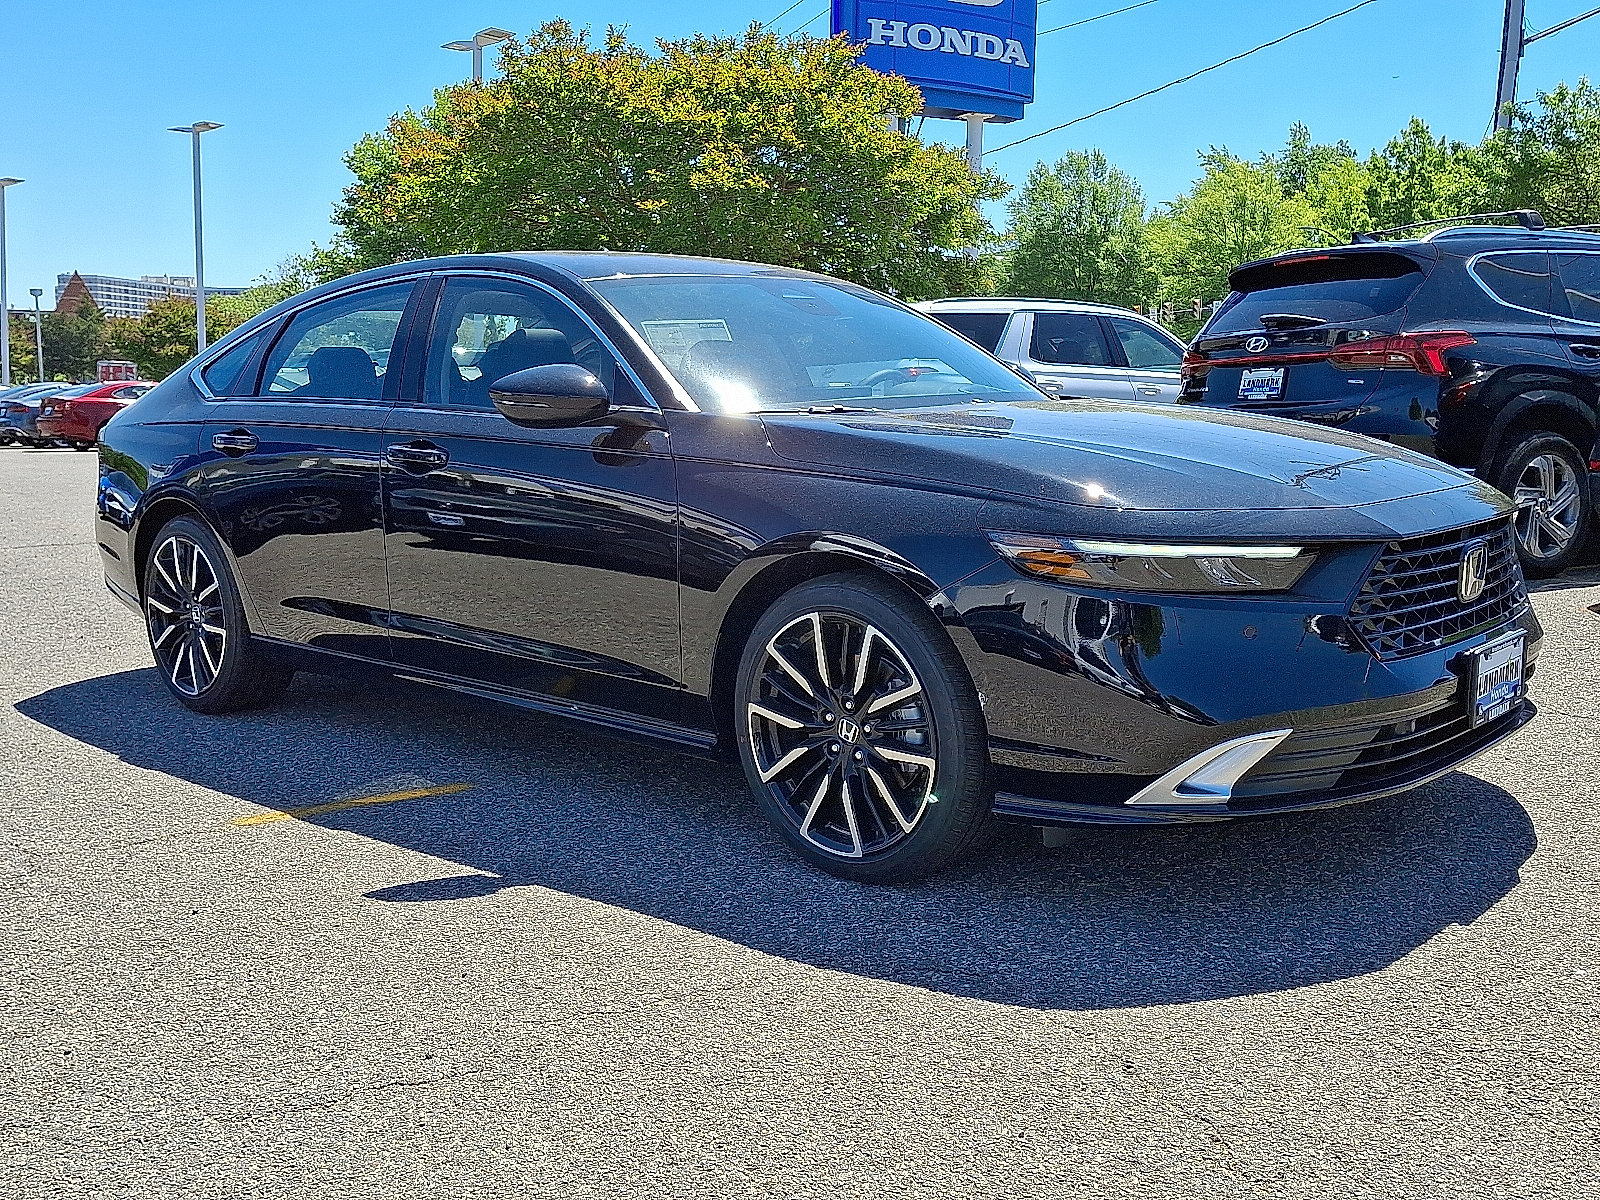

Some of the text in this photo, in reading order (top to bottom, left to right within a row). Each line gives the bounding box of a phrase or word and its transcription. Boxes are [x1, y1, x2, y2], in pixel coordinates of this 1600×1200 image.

[866, 18, 1030, 68] HONDA
[1478, 659, 1520, 696] LANDMARK
[1490, 683, 1510, 702] Honda
